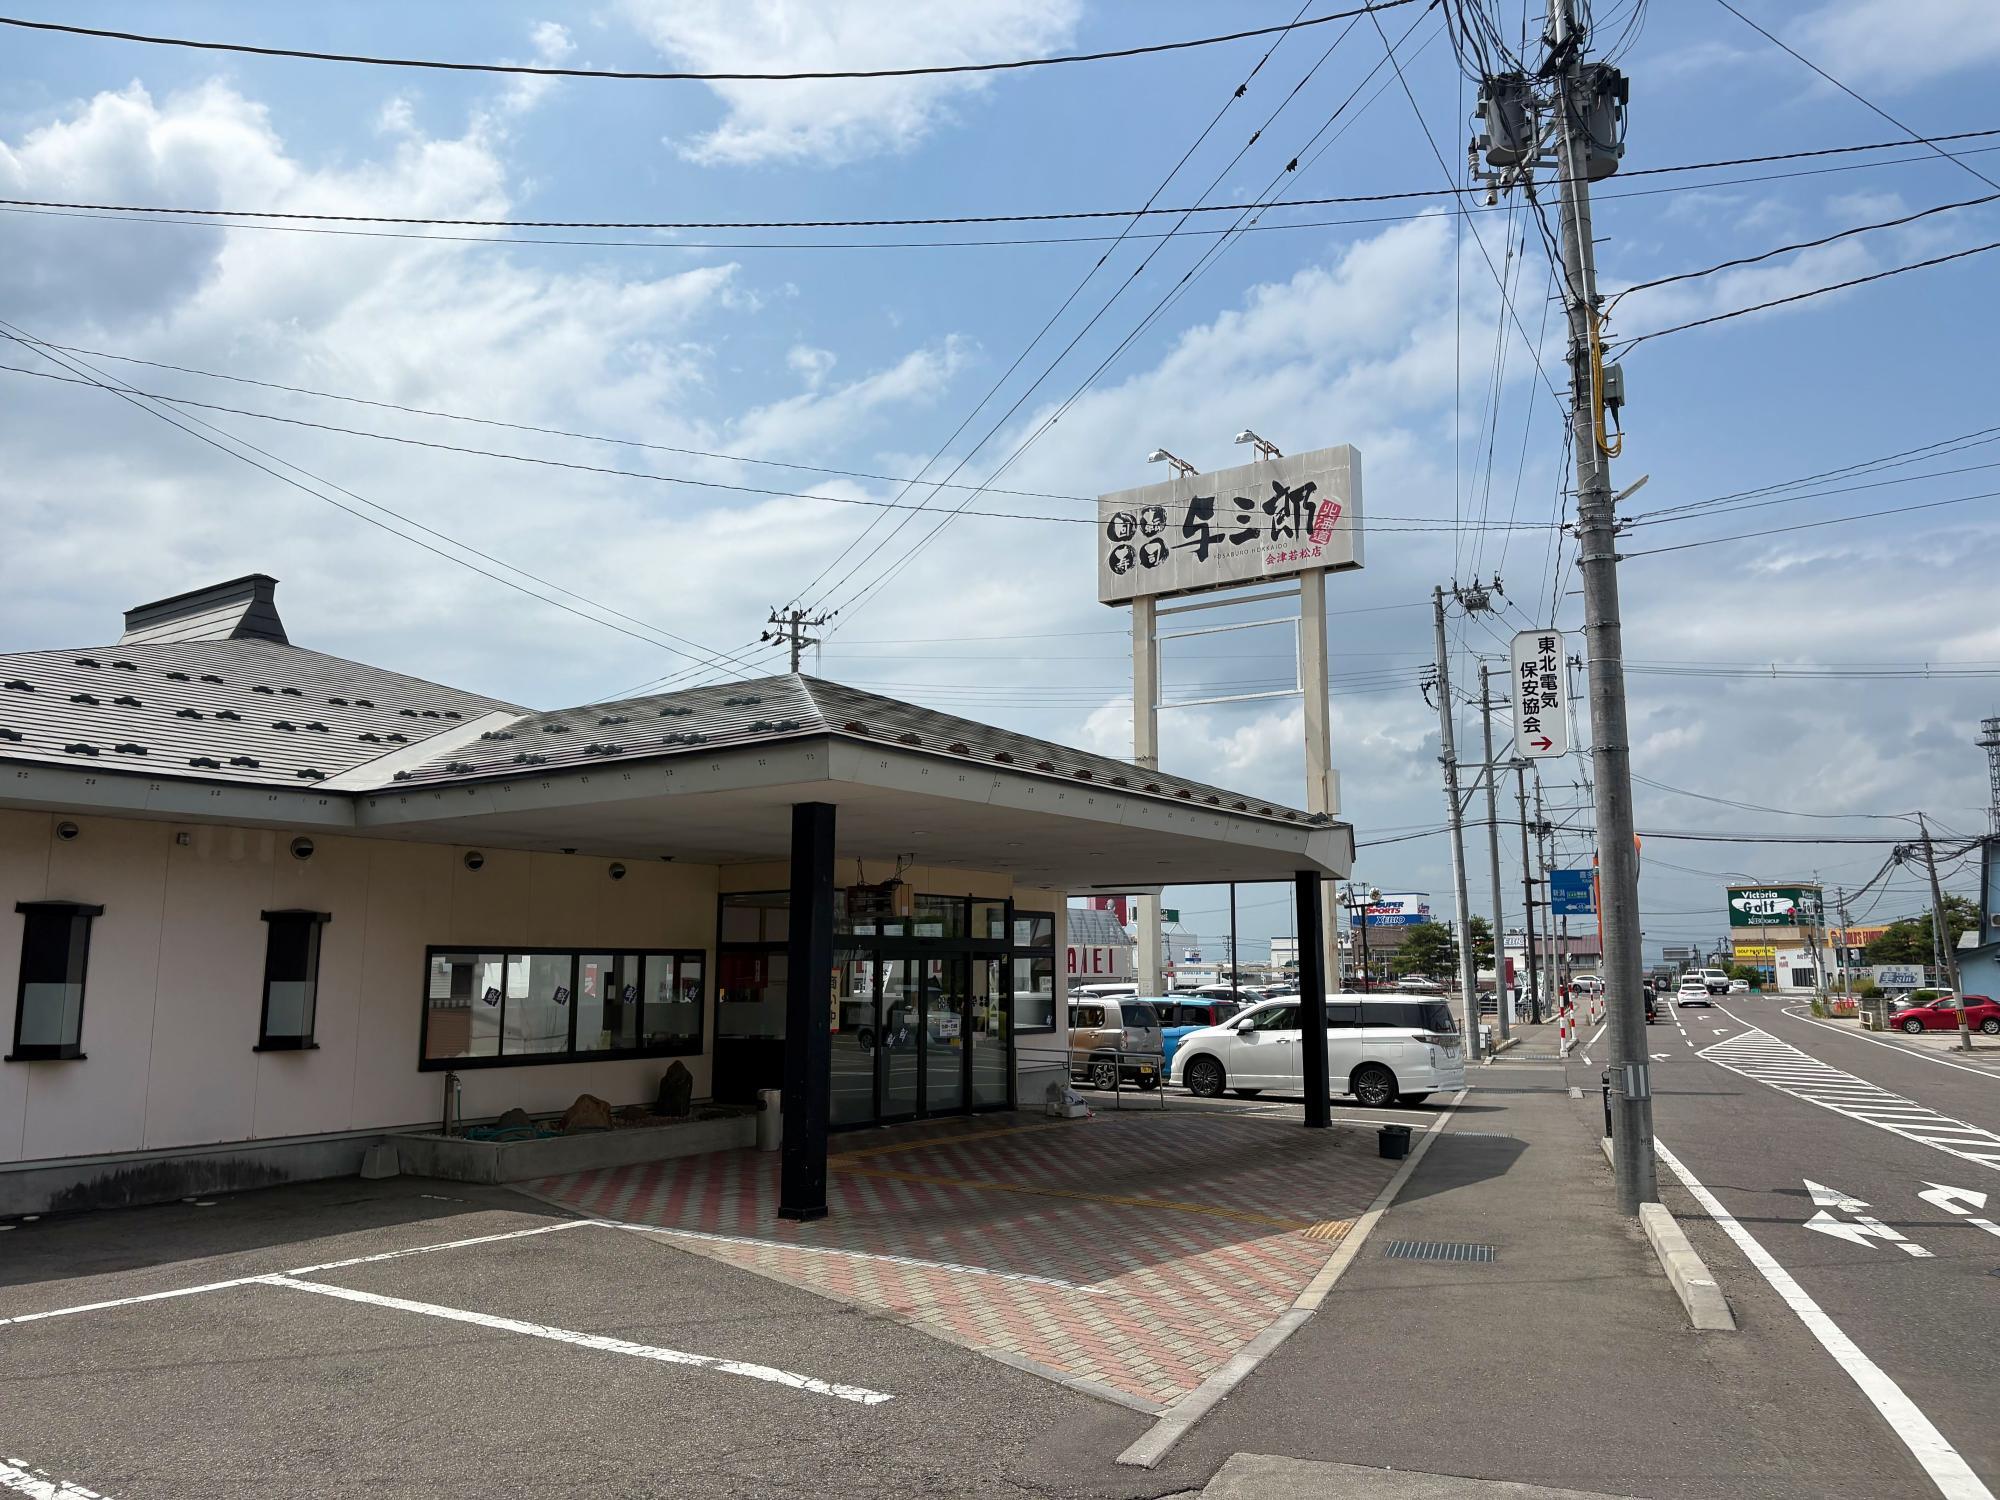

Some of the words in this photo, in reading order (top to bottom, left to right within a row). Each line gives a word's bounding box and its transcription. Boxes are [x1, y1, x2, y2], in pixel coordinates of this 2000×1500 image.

[1171, 480, 1317, 562] 与三郎
[1308, 498, 1342, 546] 北海道
[1213, 550, 1249, 559] YOSABURO
[1251, 542, 1288, 554] HOKKAIDO
[1265, 546, 1322, 565] 会津若松店
[1538, 636, 1558, 709] 東北電気
[1520, 661, 1541, 734] 保安協会
[1741, 890, 1778, 899] Victoria
[1743, 900, 1775, 913] Golf
